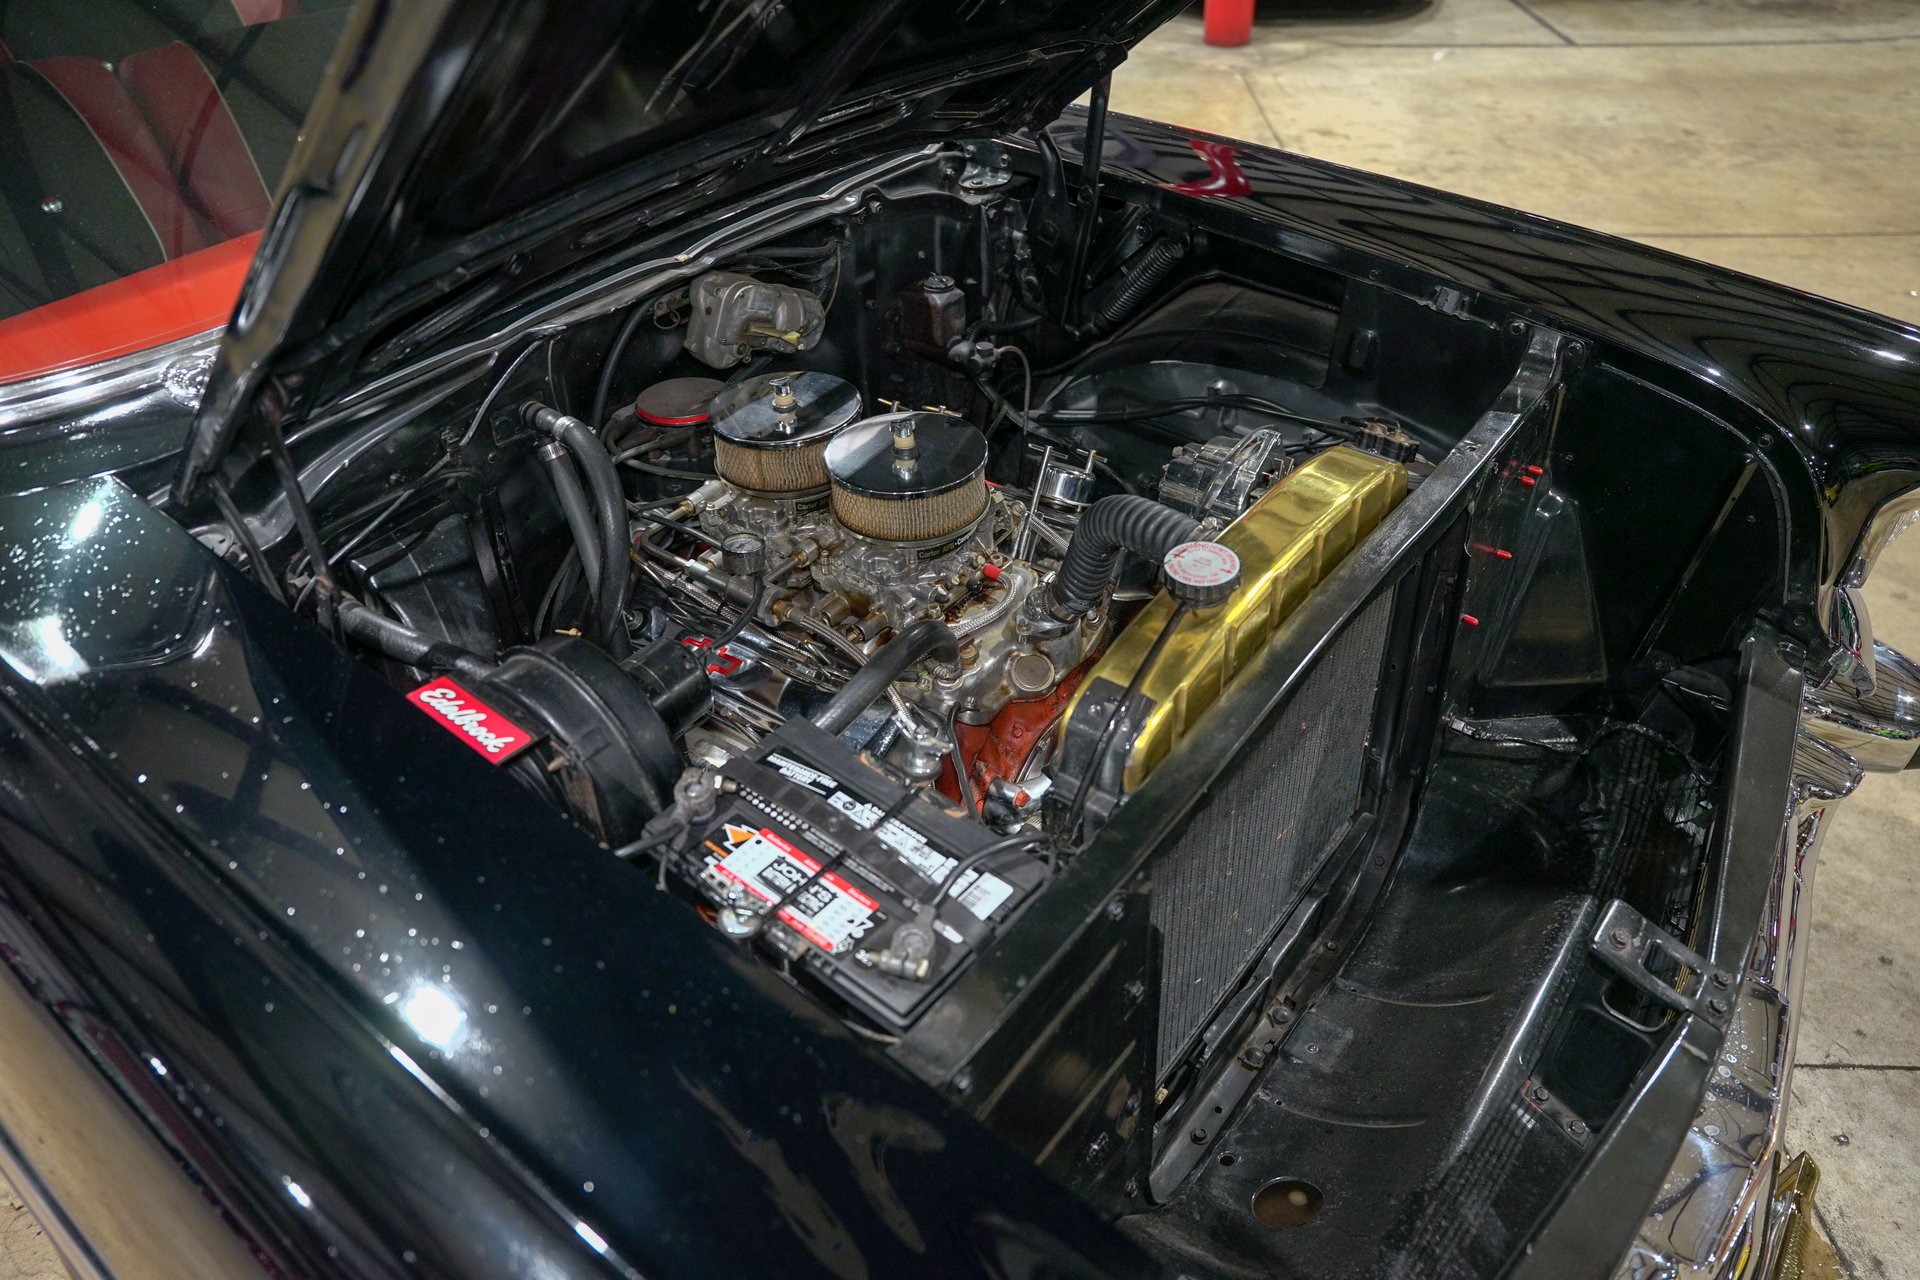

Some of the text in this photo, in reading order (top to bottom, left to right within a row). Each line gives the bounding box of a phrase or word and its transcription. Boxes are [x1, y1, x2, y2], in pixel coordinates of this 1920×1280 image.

[919, 549, 941, 559] Carter
[943, 543, 955, 553] AFB
[420, 688, 515, 753] Edelbrock
